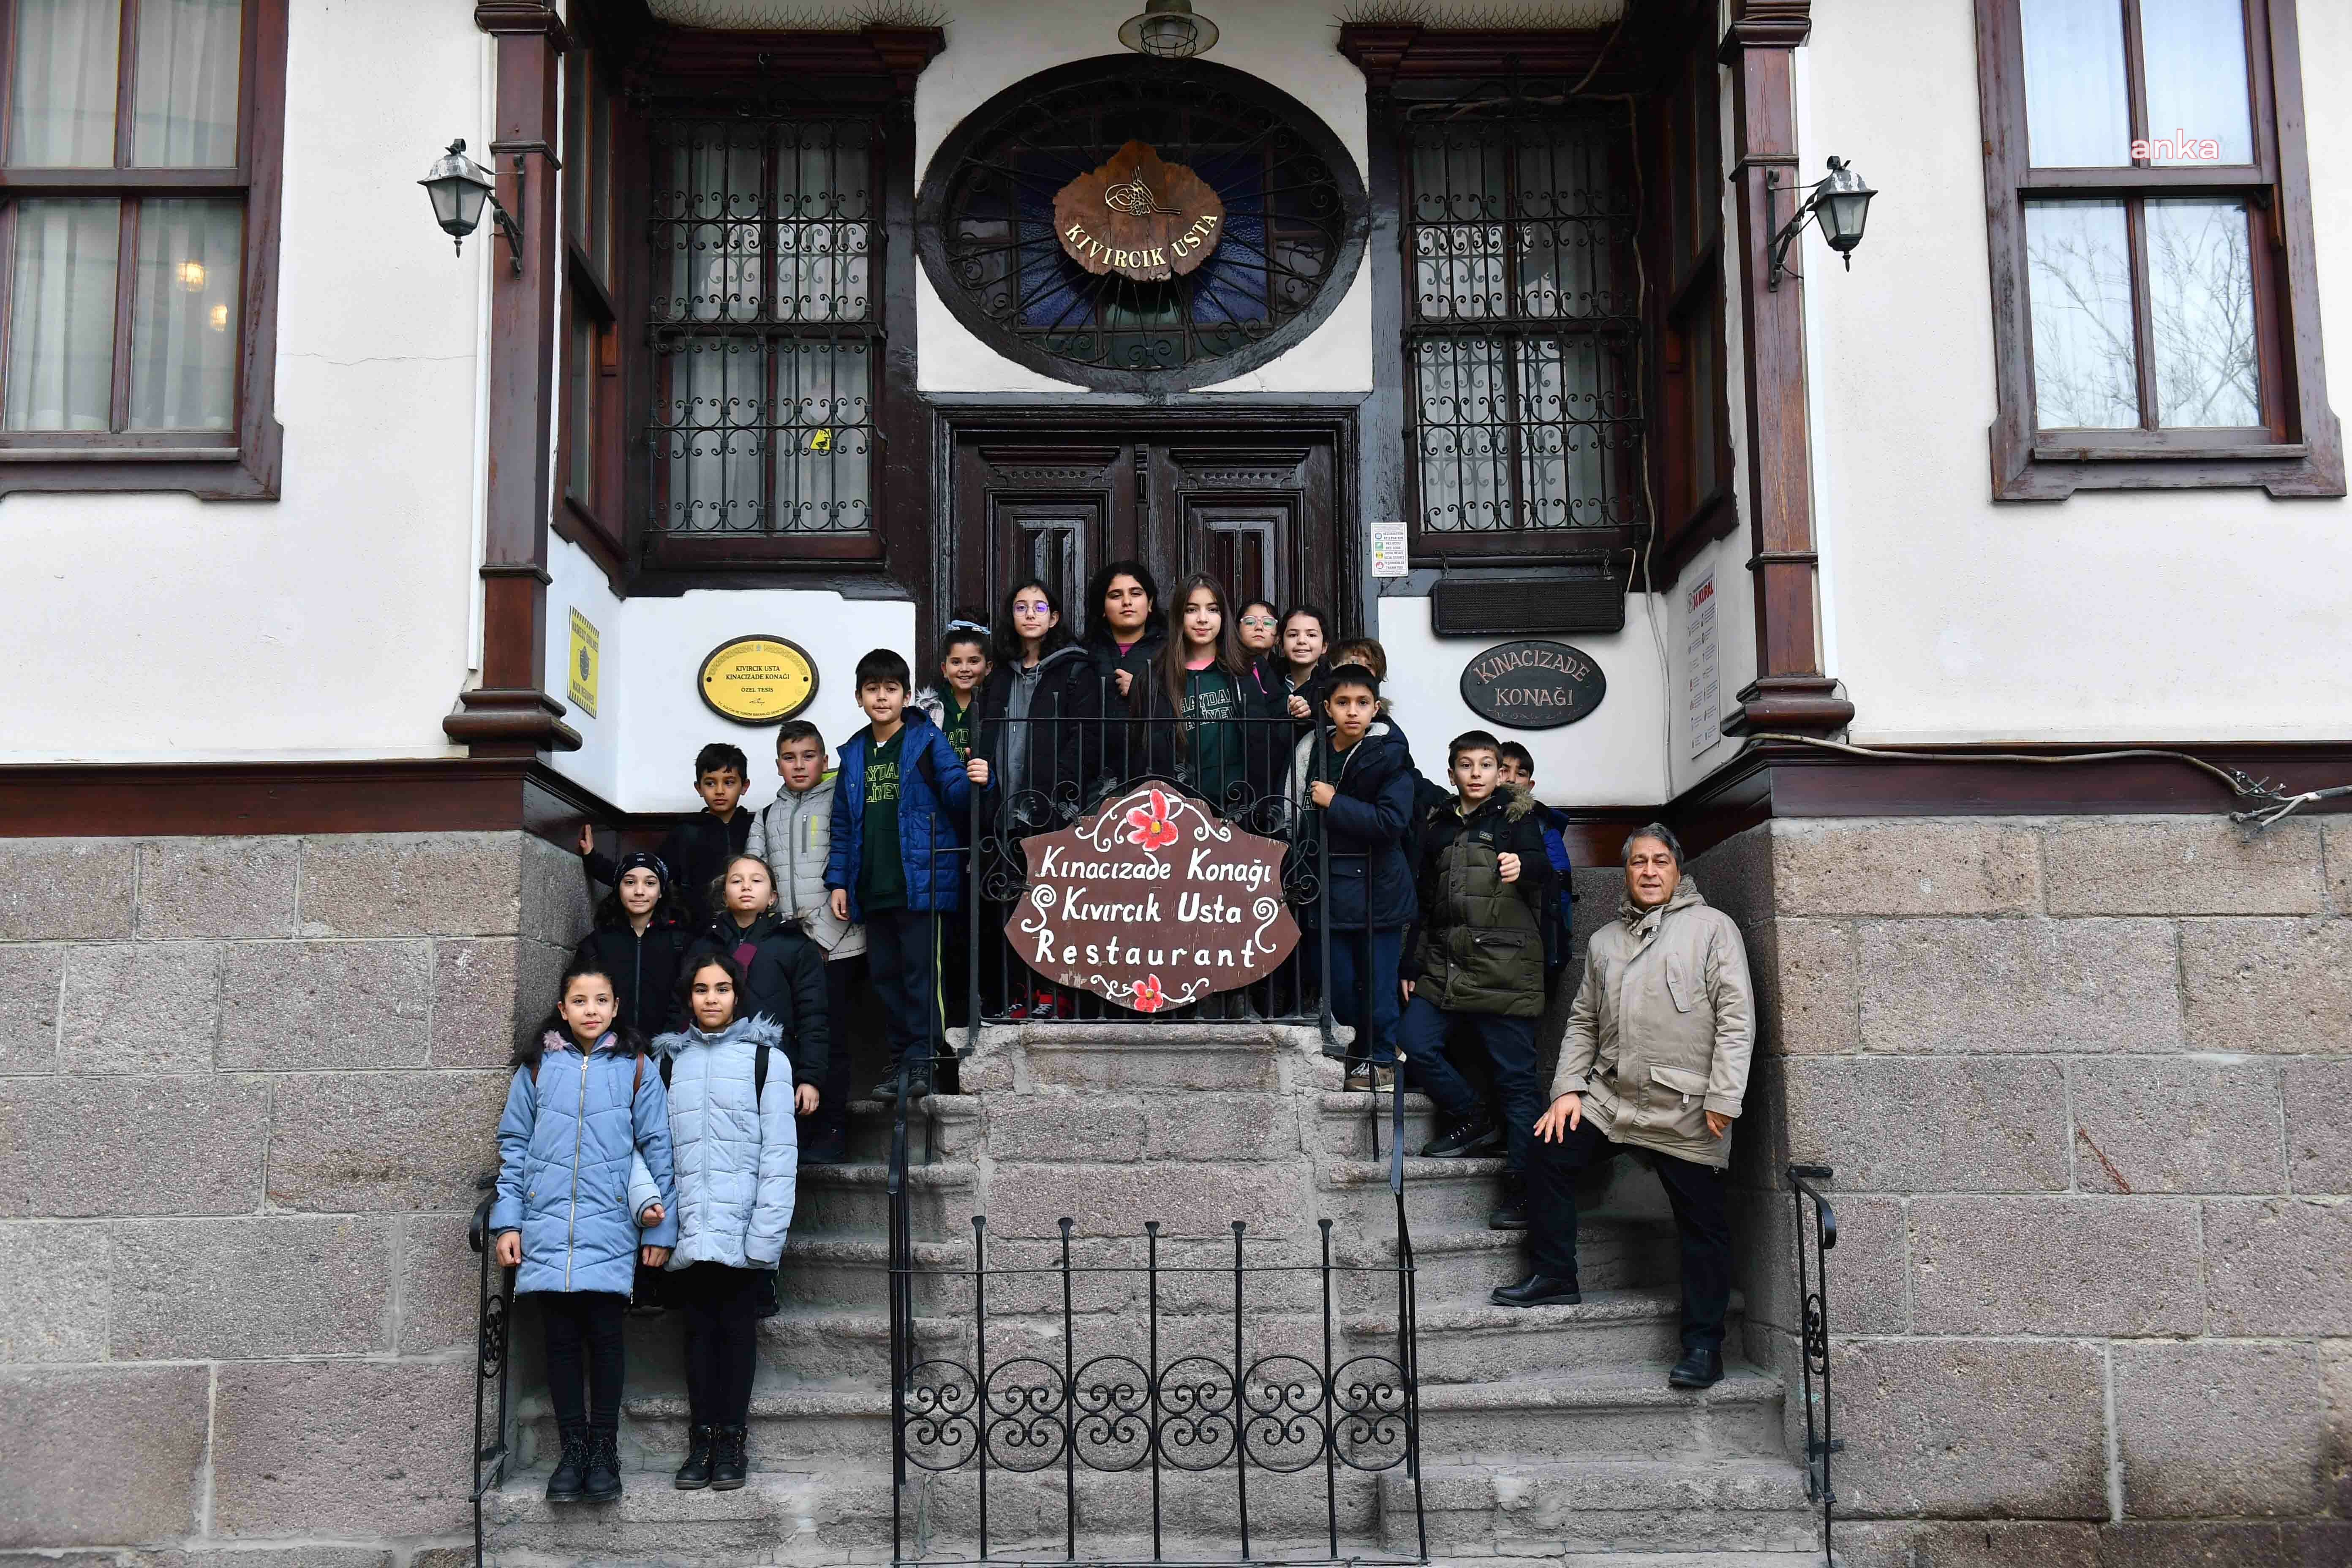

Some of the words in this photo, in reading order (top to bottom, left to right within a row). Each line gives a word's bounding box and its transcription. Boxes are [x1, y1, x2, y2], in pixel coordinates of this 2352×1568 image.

[1065, 223, 1166, 269] KIVIRCIK
[1171, 215, 1218, 257] USTA
[1693, 594, 1698, 610] 14
[1699, 580, 1714, 604] KURAL
[1473, 650, 1590, 684] KINACIZADE
[1180, 688, 1232, 713] AYDA
[1494, 687, 1573, 706] KONAĞI
[865, 762, 899, 782] YDA
[1040, 845, 1171, 881] Kınacızade
[1187, 848, 1271, 891] Konağı
[1062, 886, 1162, 923] Kıvırcık
[1178, 892, 1241, 923] Usta
[1035, 929, 1255, 968] Restaurant
